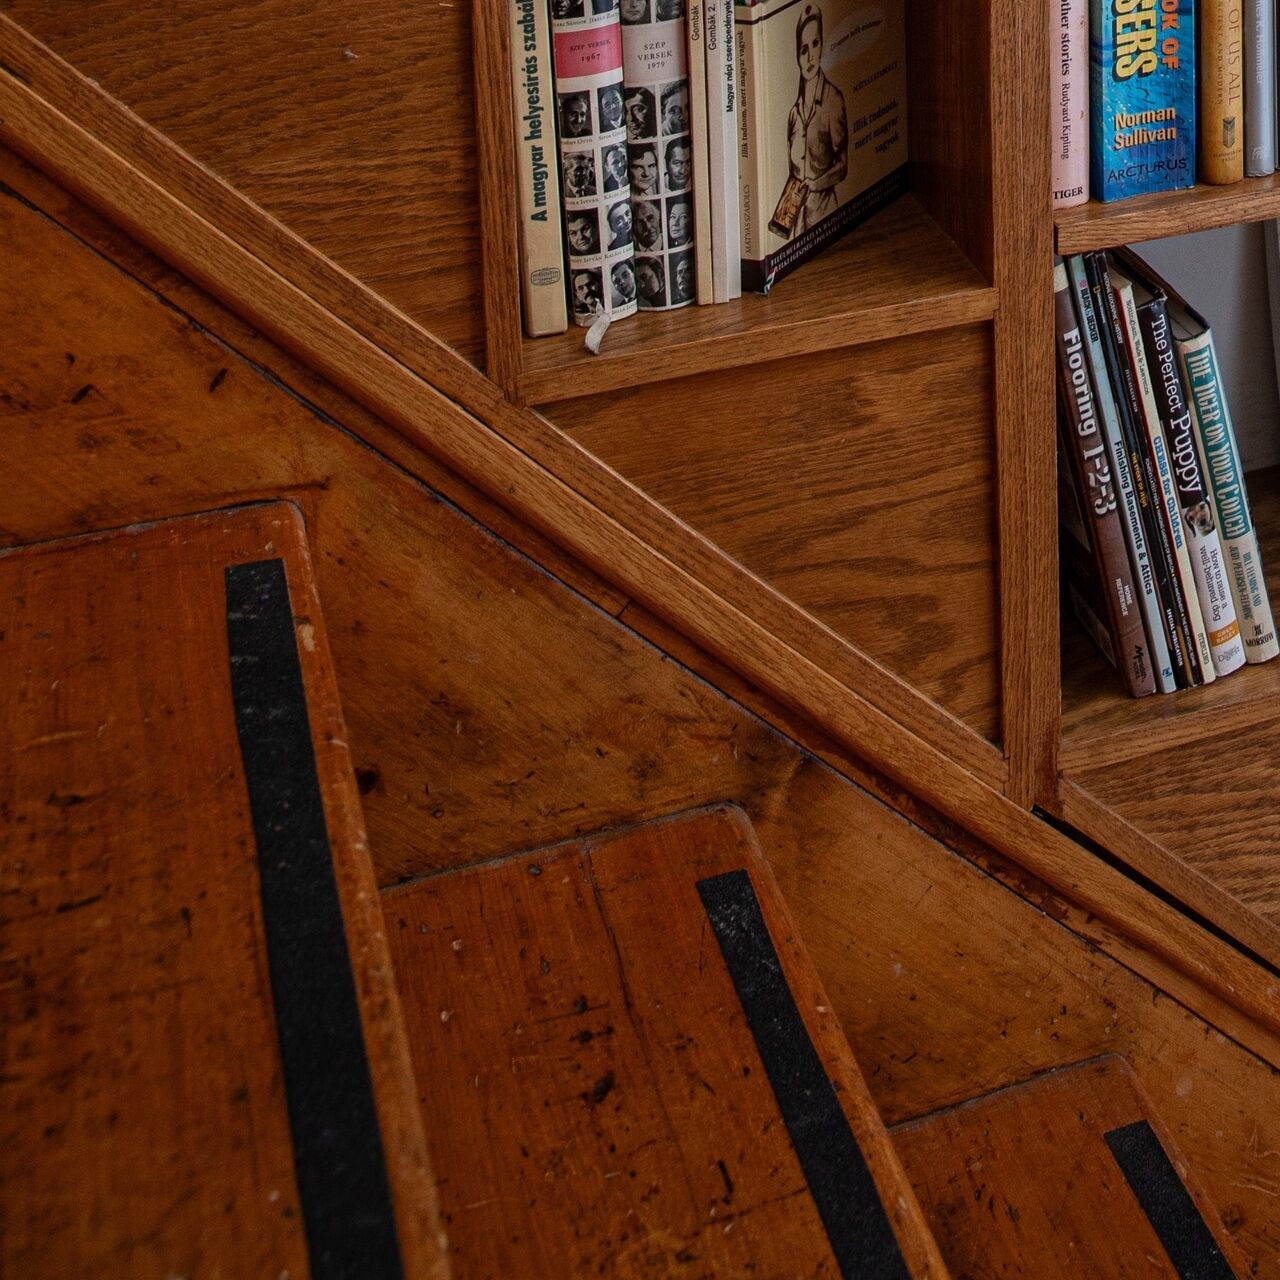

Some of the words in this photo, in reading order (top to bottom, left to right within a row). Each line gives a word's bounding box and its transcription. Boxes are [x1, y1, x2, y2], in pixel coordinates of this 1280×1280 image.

[708, 3, 716, 13] 2.
[708, 14, 717, 51] Gombák
[637, 50, 673, 62] VERSEK
[643, 41, 666, 51] SZÉP
[647, 60, 665, 70] 1979
[519, 55, 544, 142] helyesírás
[1114, 106, 1176, 130] Norman
[1114, 125, 1177, 150] Sullivan
[525, 146, 548, 203] magyar
[1052, 186, 1084, 200] TIGER
[530, 208, 548, 222] A
[1150, 314, 1168, 349] The
[1156, 350, 1181, 409] Perfect
[1062, 331, 1097, 437] Flooring
[1083, 439, 1117, 515] 1-2-3
[1167, 409, 1202, 494] Puppy
